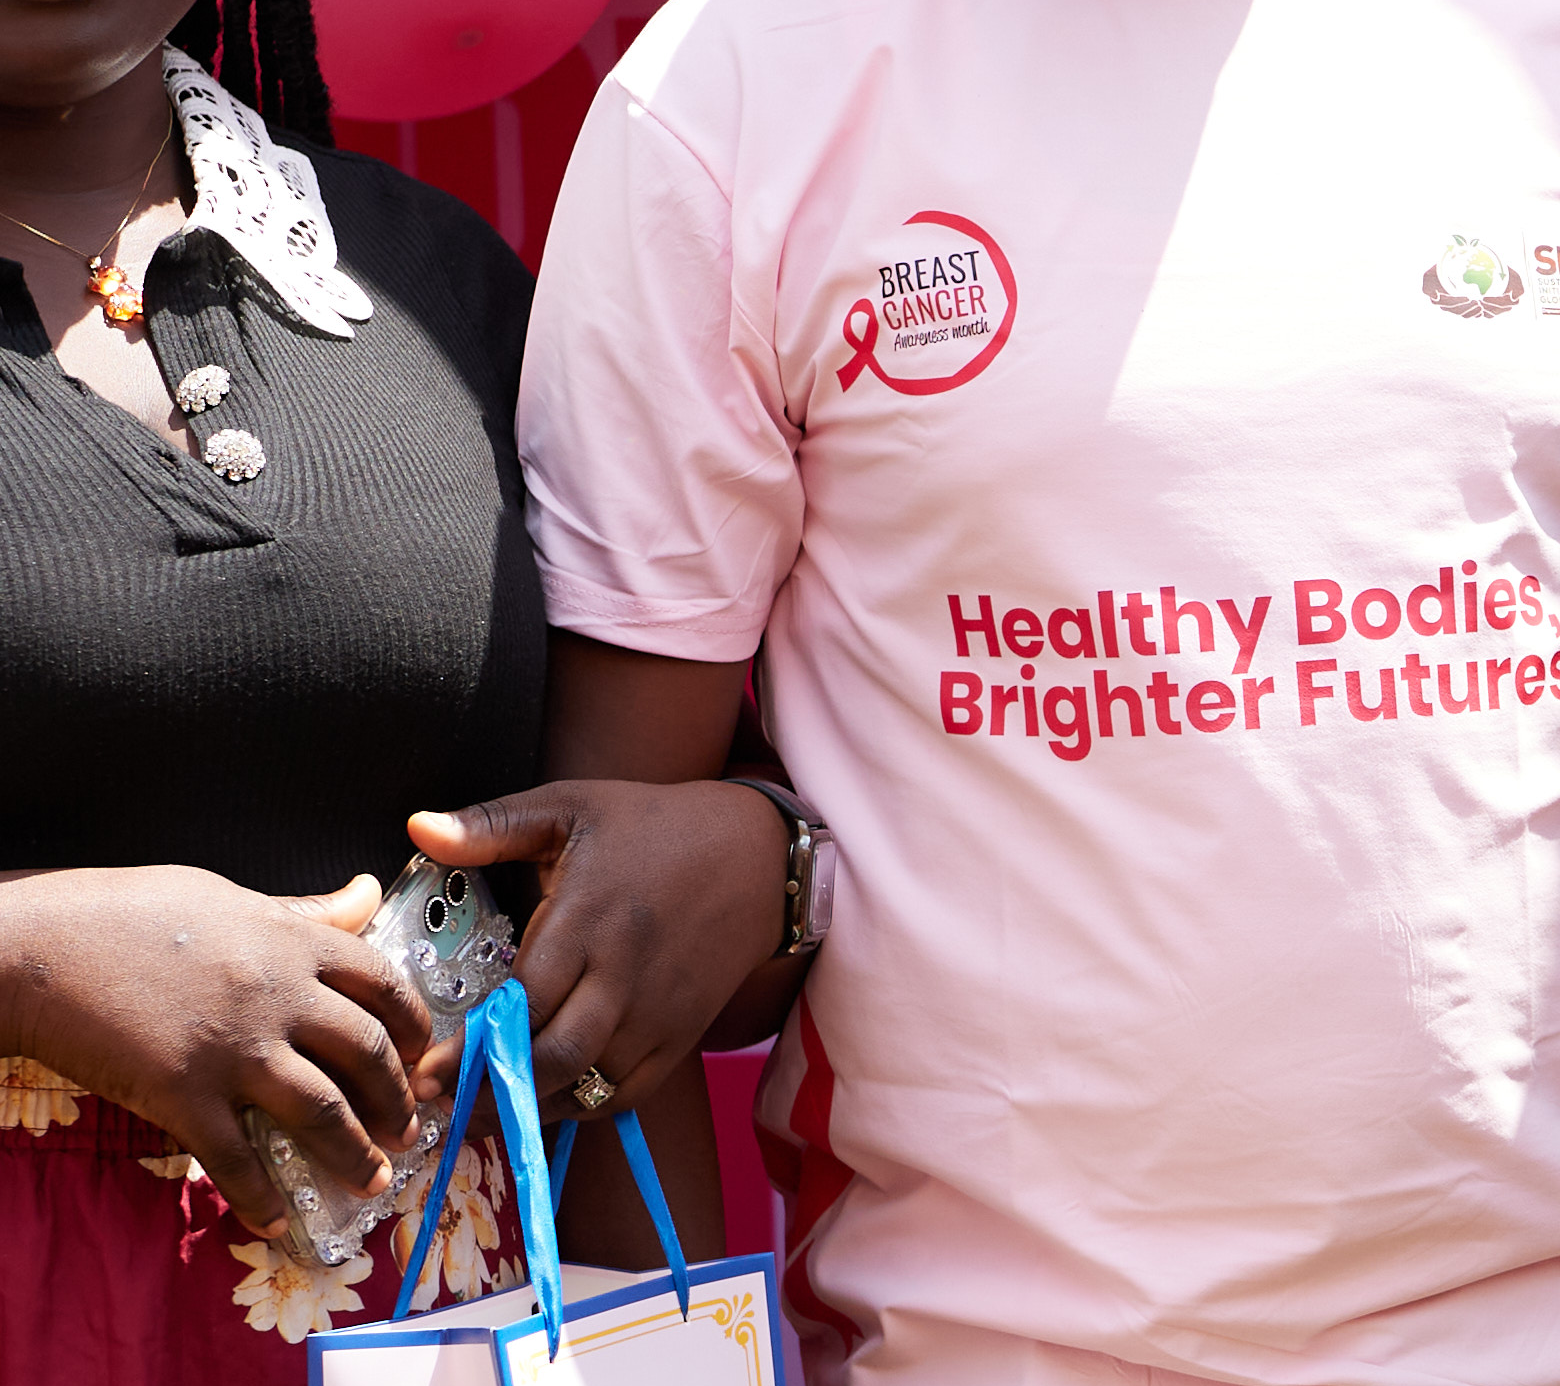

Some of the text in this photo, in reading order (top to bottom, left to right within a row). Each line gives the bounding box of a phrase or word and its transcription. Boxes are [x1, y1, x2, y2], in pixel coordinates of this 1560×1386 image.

[879, 251, 979, 298] BREAST
[882, 285, 987, 330] CANCER
[894, 317, 991, 351] Awareness month
[947, 586, 1272, 674] Healthy
[940, 664, 1274, 761] Brighter
